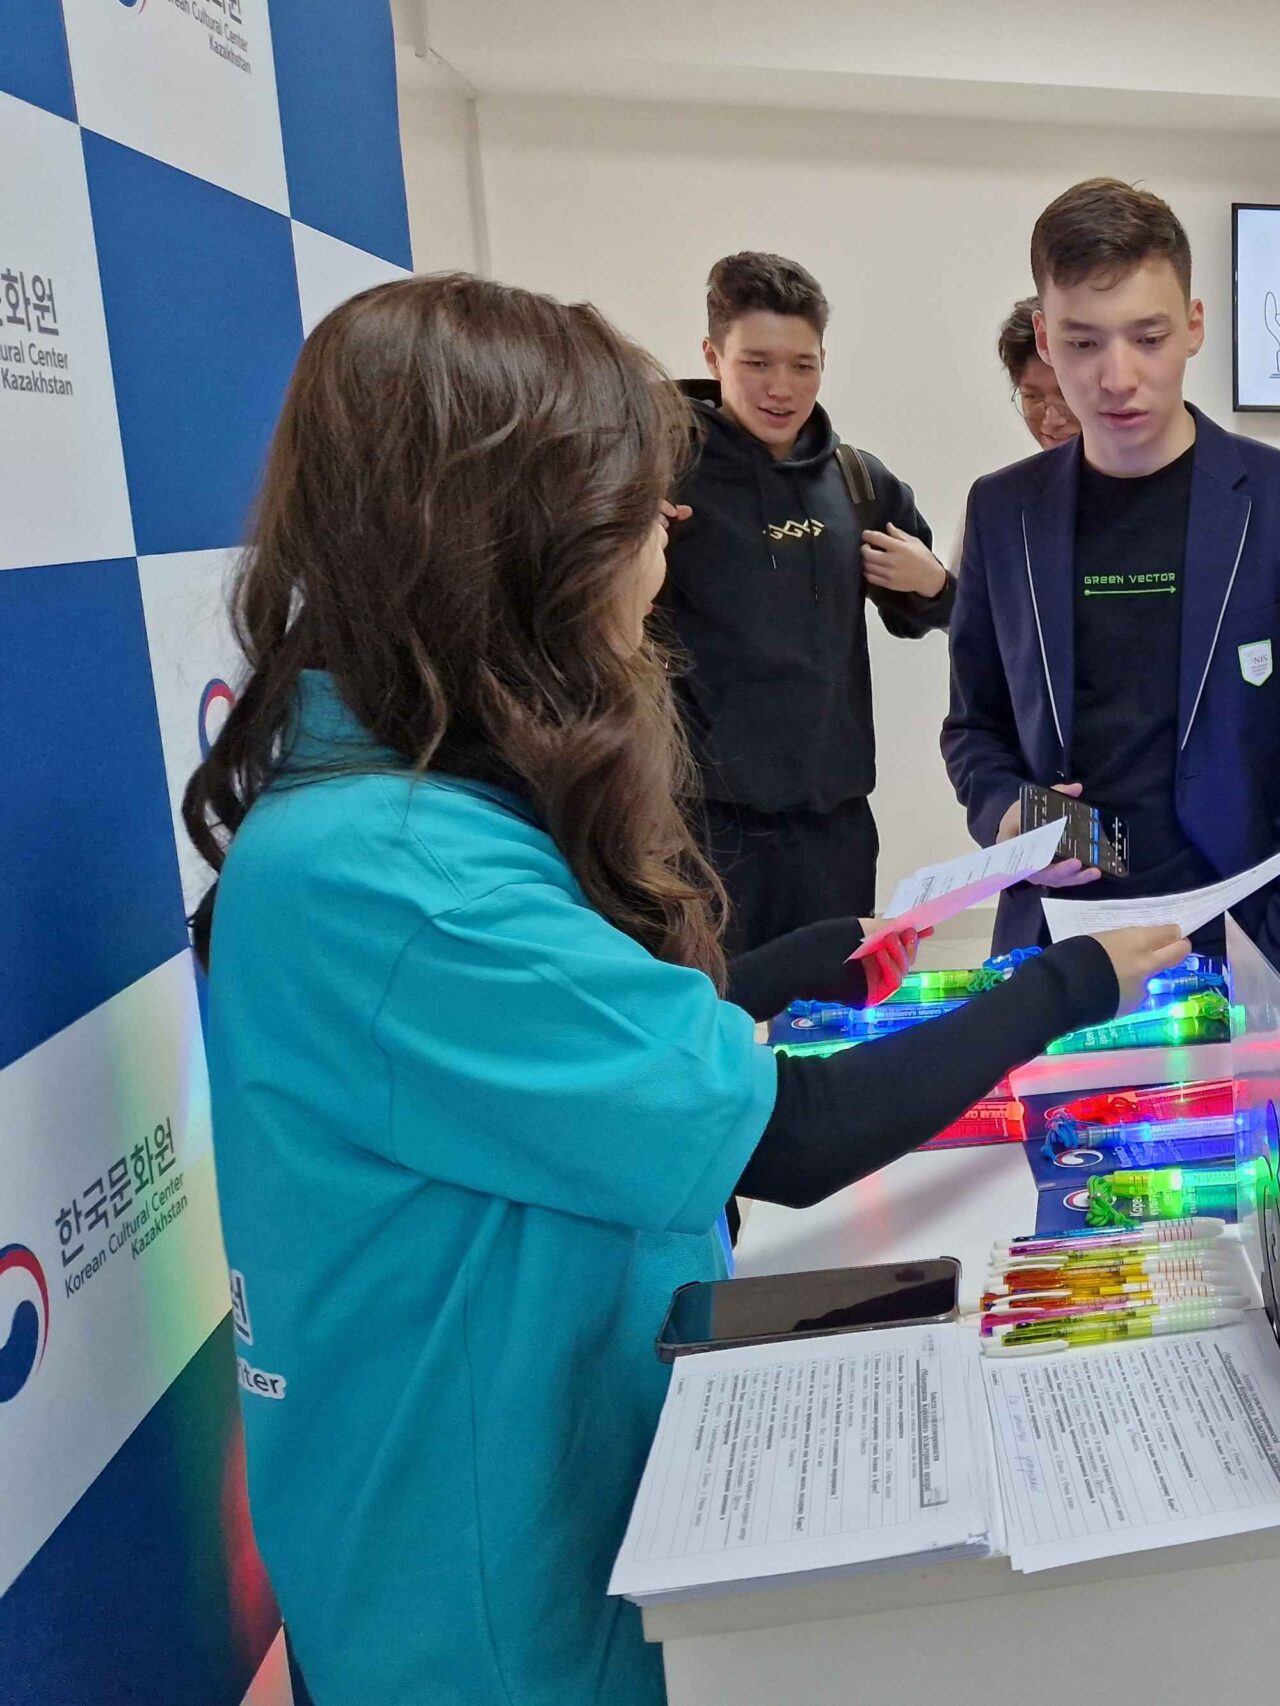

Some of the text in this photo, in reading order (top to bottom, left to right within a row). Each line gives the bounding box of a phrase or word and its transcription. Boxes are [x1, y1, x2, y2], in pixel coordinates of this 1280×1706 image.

[208, 33, 251, 74] Kazakhstan
[224, 23, 248, 52] Center
[28, 342, 69, 369] Center
[1, 367, 74, 396] Kazakhstan
[55, 1116, 176, 1268] 한국문화원
[64, 1172, 185, 1299] Korean Cultural Center
[130, 1195, 188, 1260] Kazakhstan
